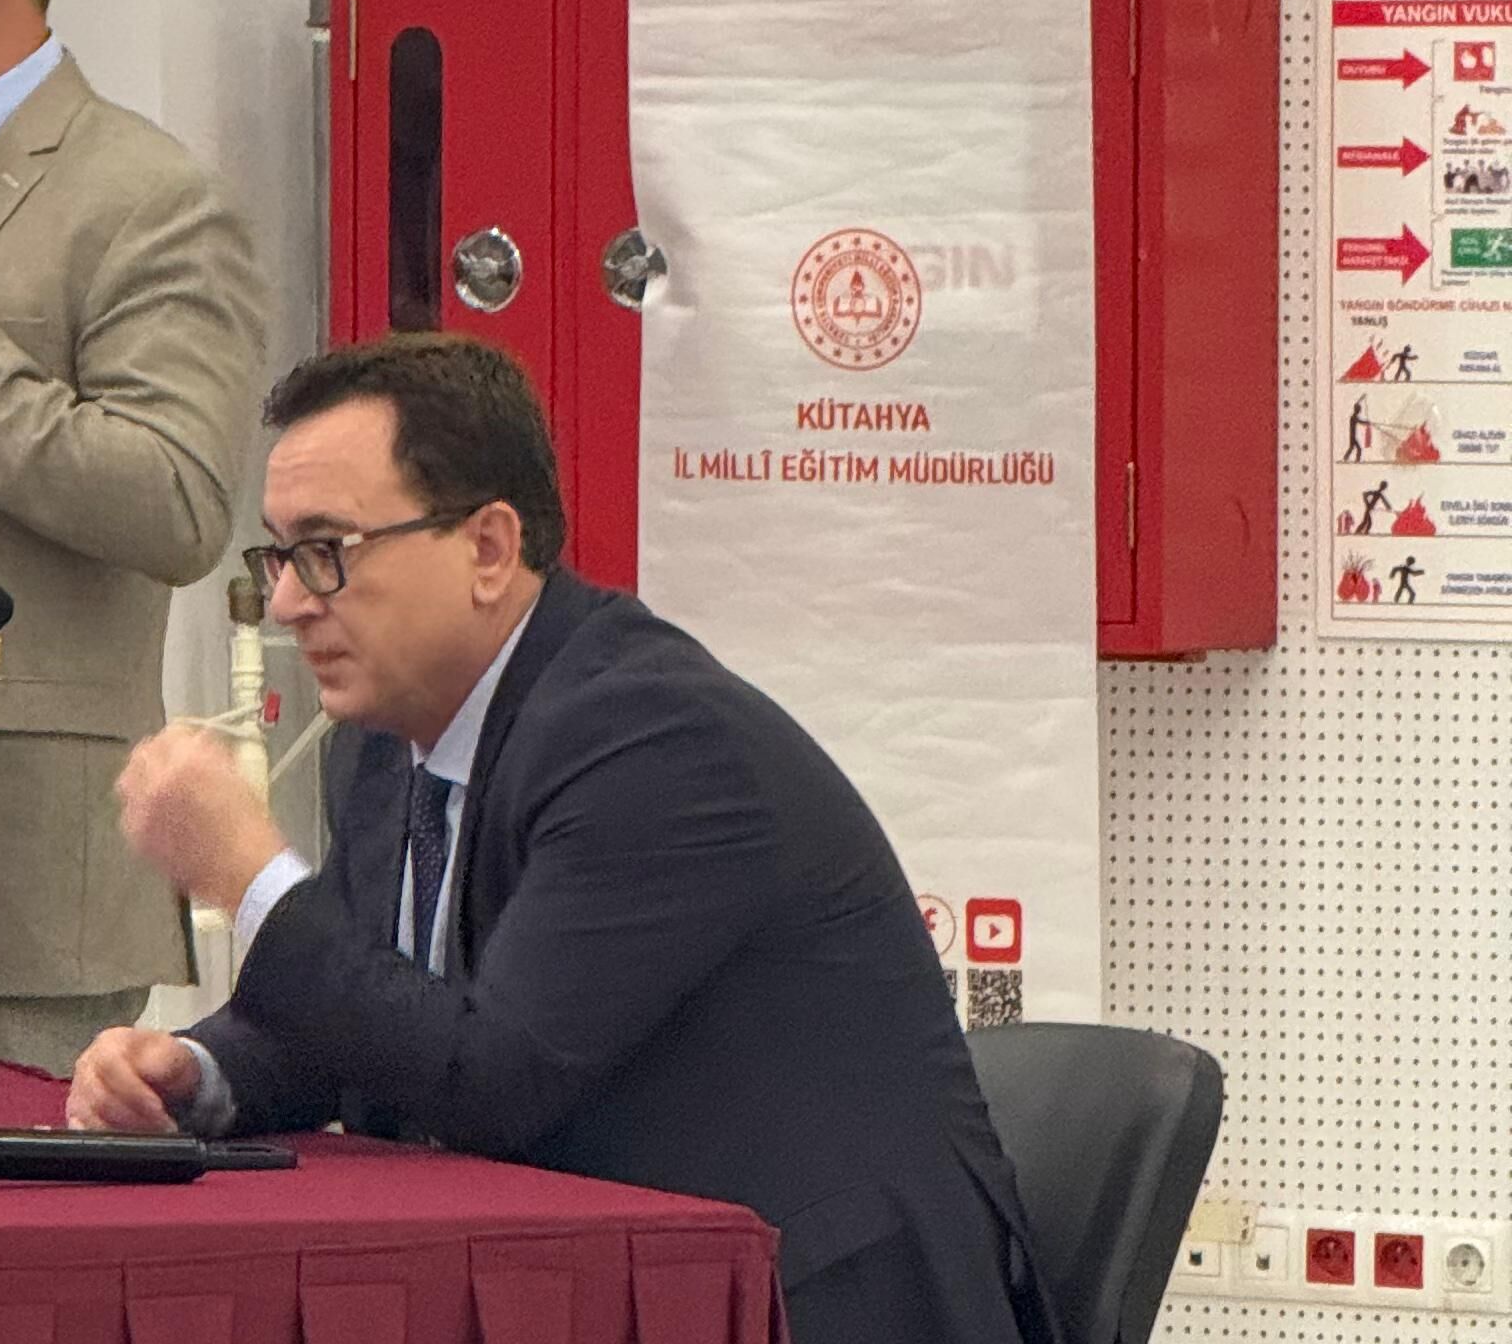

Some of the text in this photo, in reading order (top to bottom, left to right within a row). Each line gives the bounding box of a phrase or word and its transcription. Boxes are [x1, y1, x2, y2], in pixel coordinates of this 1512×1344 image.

[1382, 4, 1457, 23] YANGIN
[796, 397, 931, 432] KÜTAHYA
[673, 446, 694, 480] İL
[781, 448, 879, 483] EĞİTİM
[888, 450, 1055, 485] MÜDÜRLÜĞÜ
